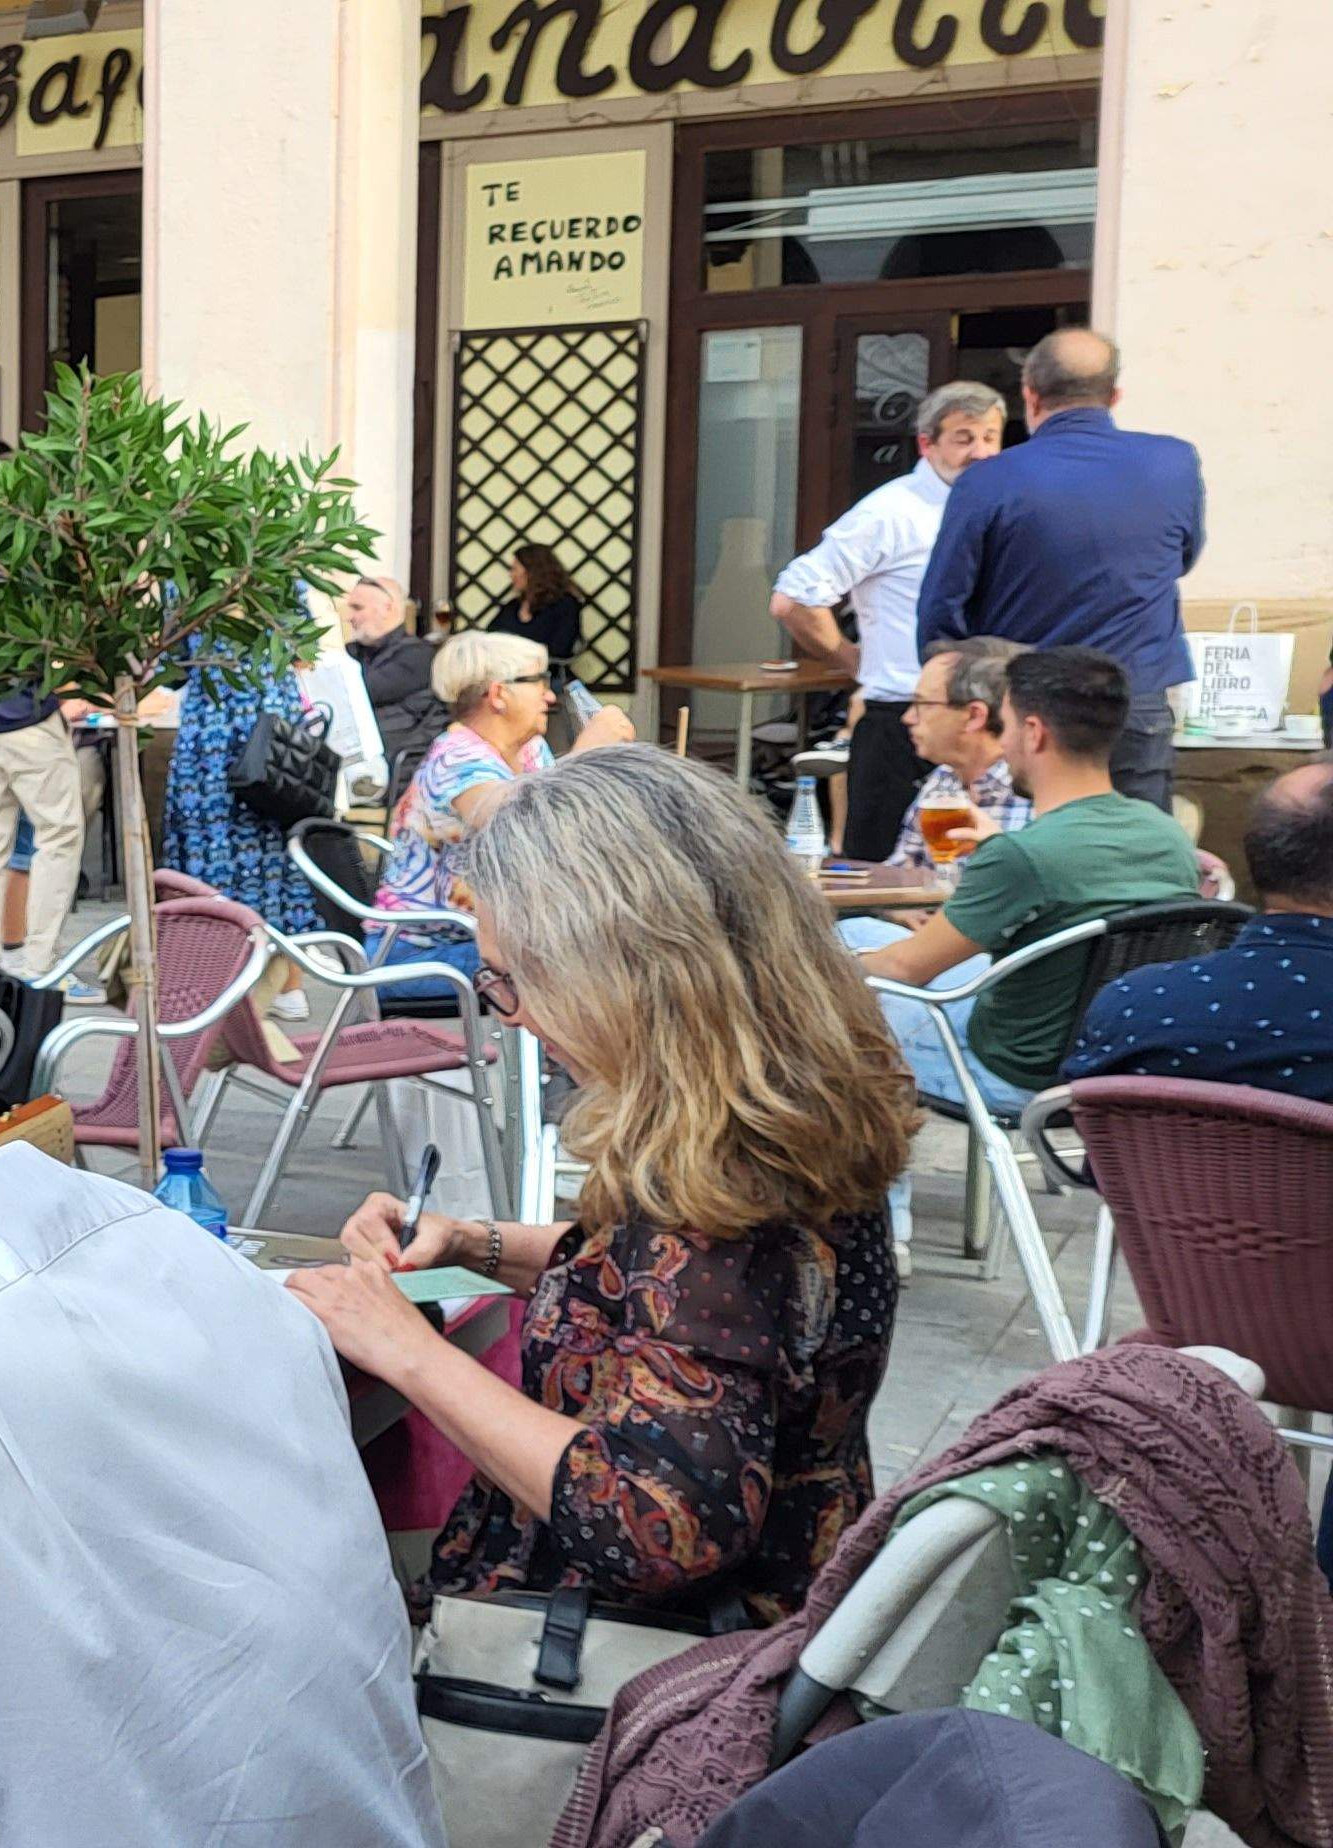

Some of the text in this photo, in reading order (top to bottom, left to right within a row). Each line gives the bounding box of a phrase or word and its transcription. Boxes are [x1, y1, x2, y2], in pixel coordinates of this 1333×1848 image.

[482, 181, 521, 207] TE
[1205, 646, 1251, 661] FERIA
[1204, 662, 1232, 675] DEL
[1202, 676, 1251, 690] LIBRO
